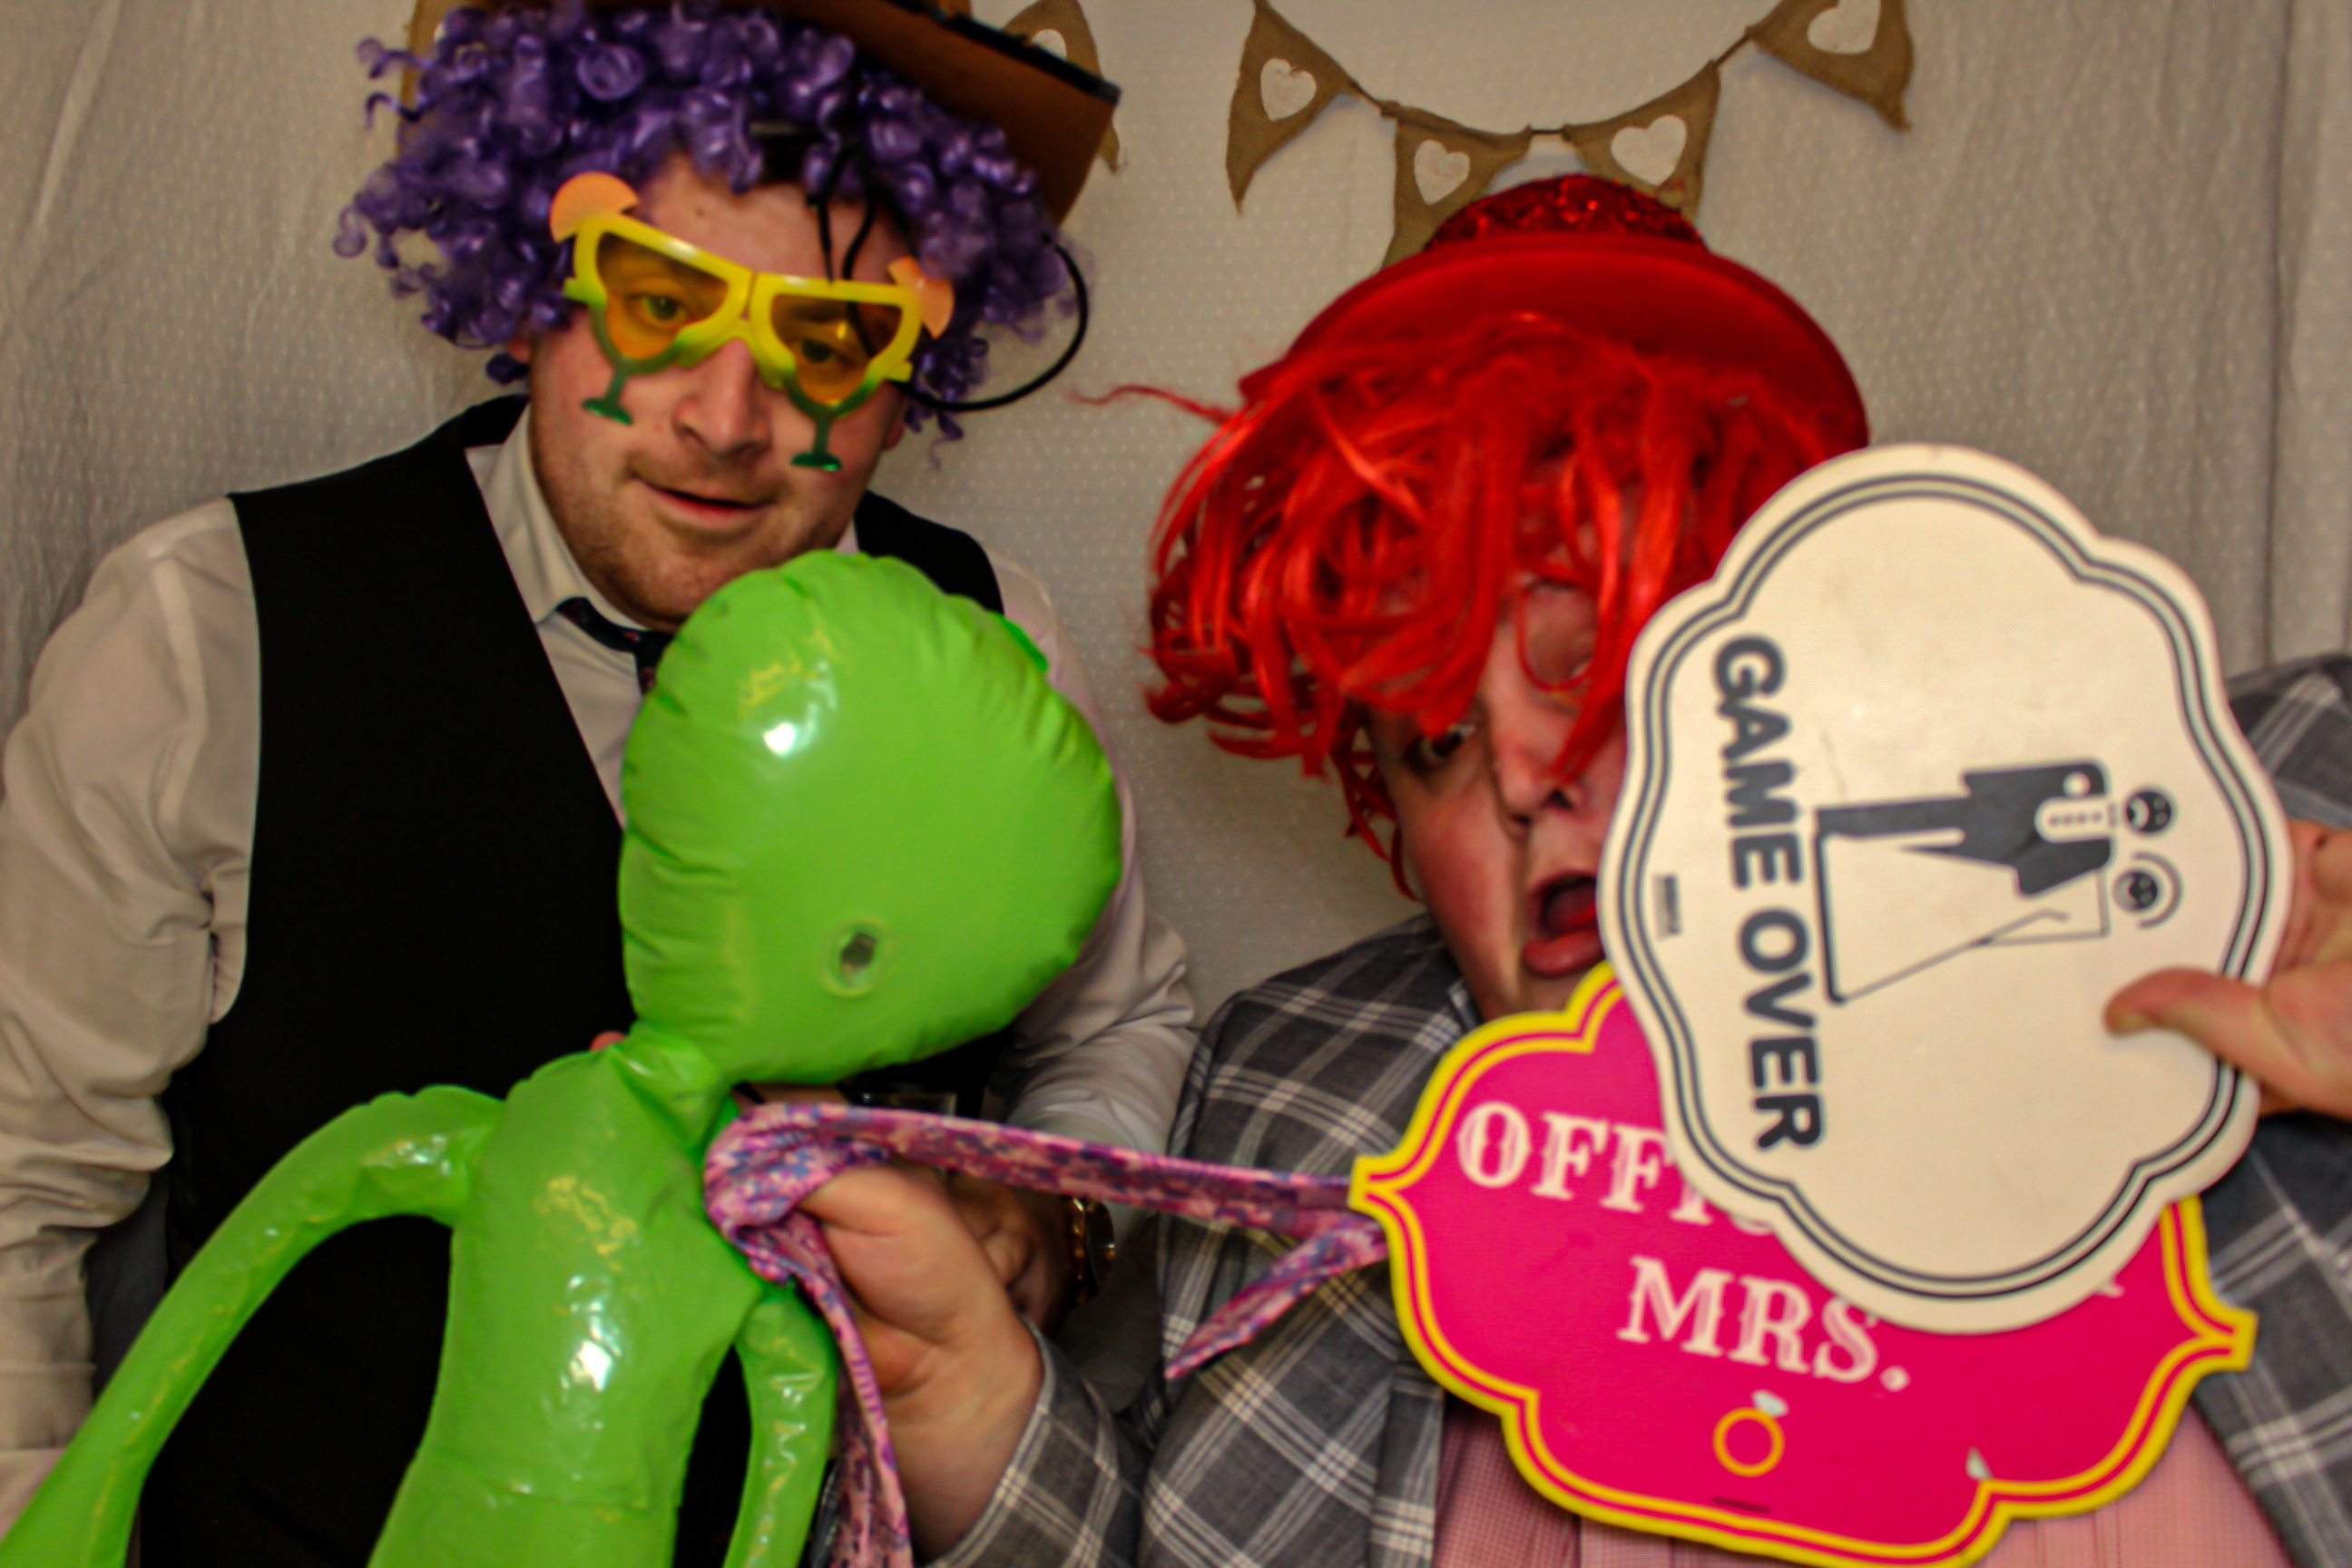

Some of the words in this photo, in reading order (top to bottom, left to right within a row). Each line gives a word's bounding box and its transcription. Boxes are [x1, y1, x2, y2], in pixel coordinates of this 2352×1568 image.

[1712, 633, 1804, 889] GAME
[1737, 907, 1826, 1151] OVER
[1616, 1254, 1909, 1392] MRS.
